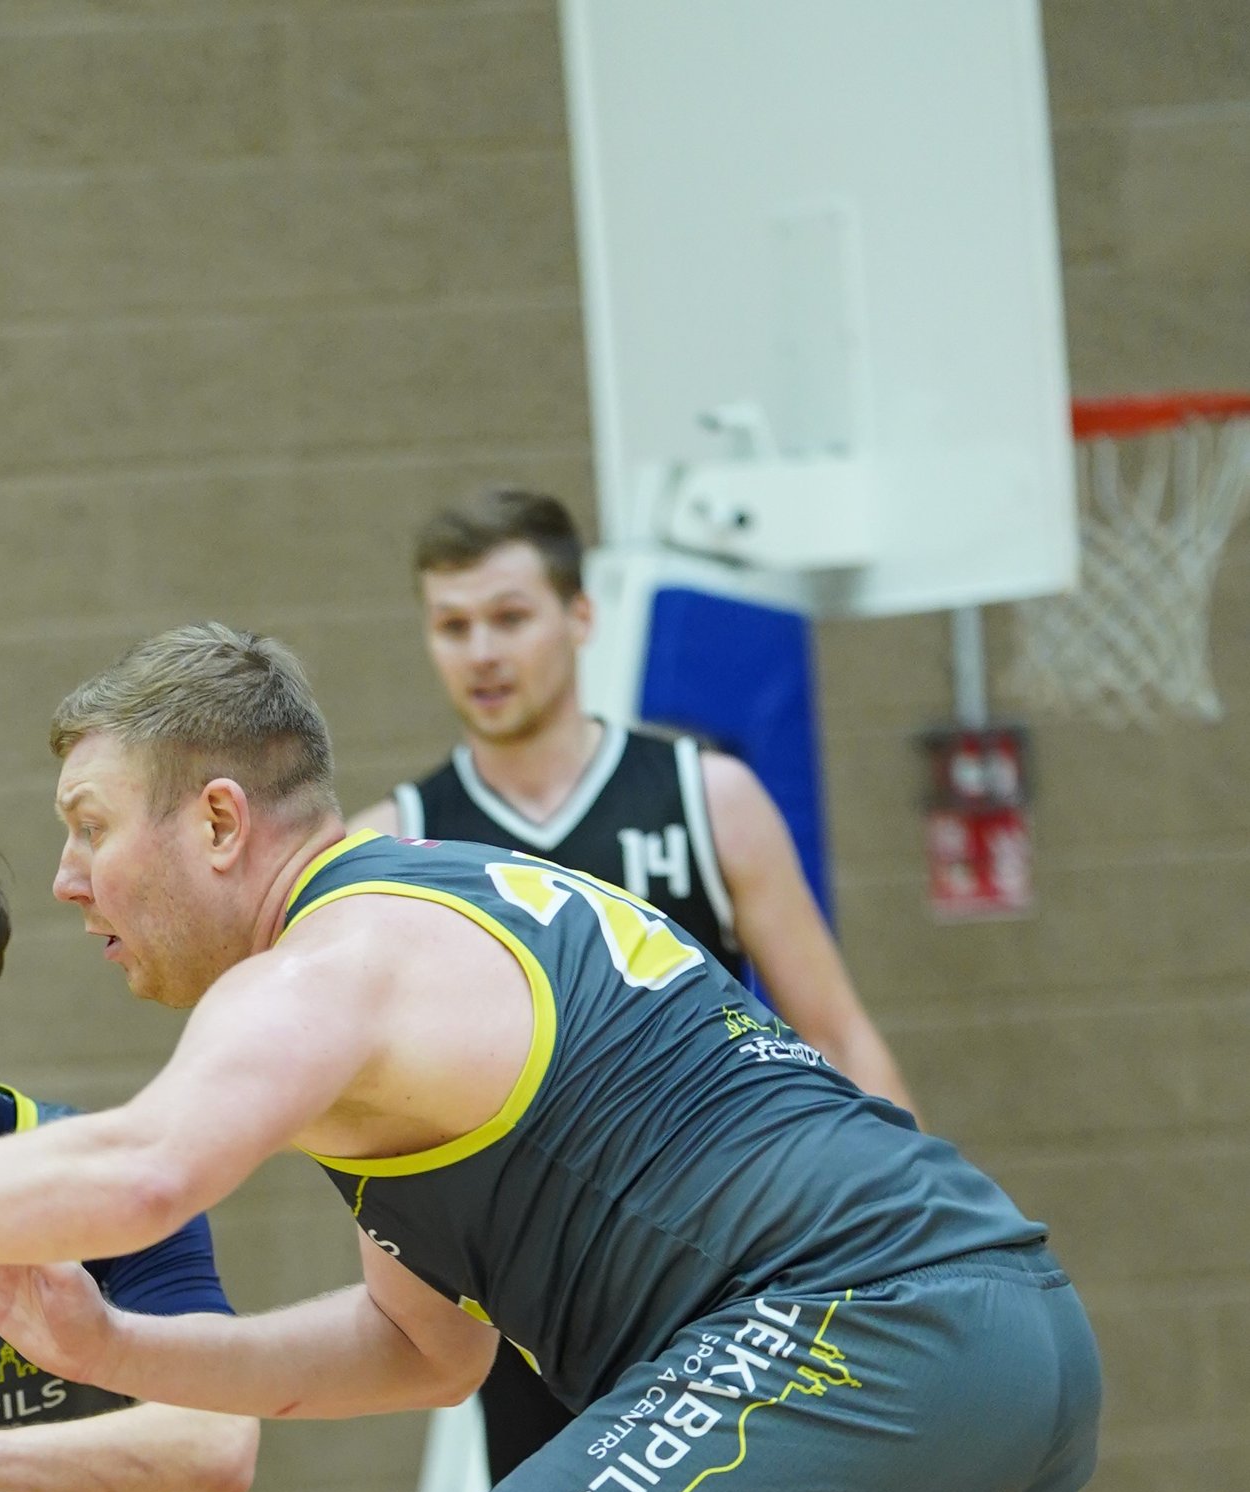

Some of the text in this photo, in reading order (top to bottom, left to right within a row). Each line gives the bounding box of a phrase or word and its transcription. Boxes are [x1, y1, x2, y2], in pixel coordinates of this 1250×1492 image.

[618, 824, 691, 899] 14
[485, 850, 706, 991] 2
[587, 1386, 667, 1460] CENTRS
